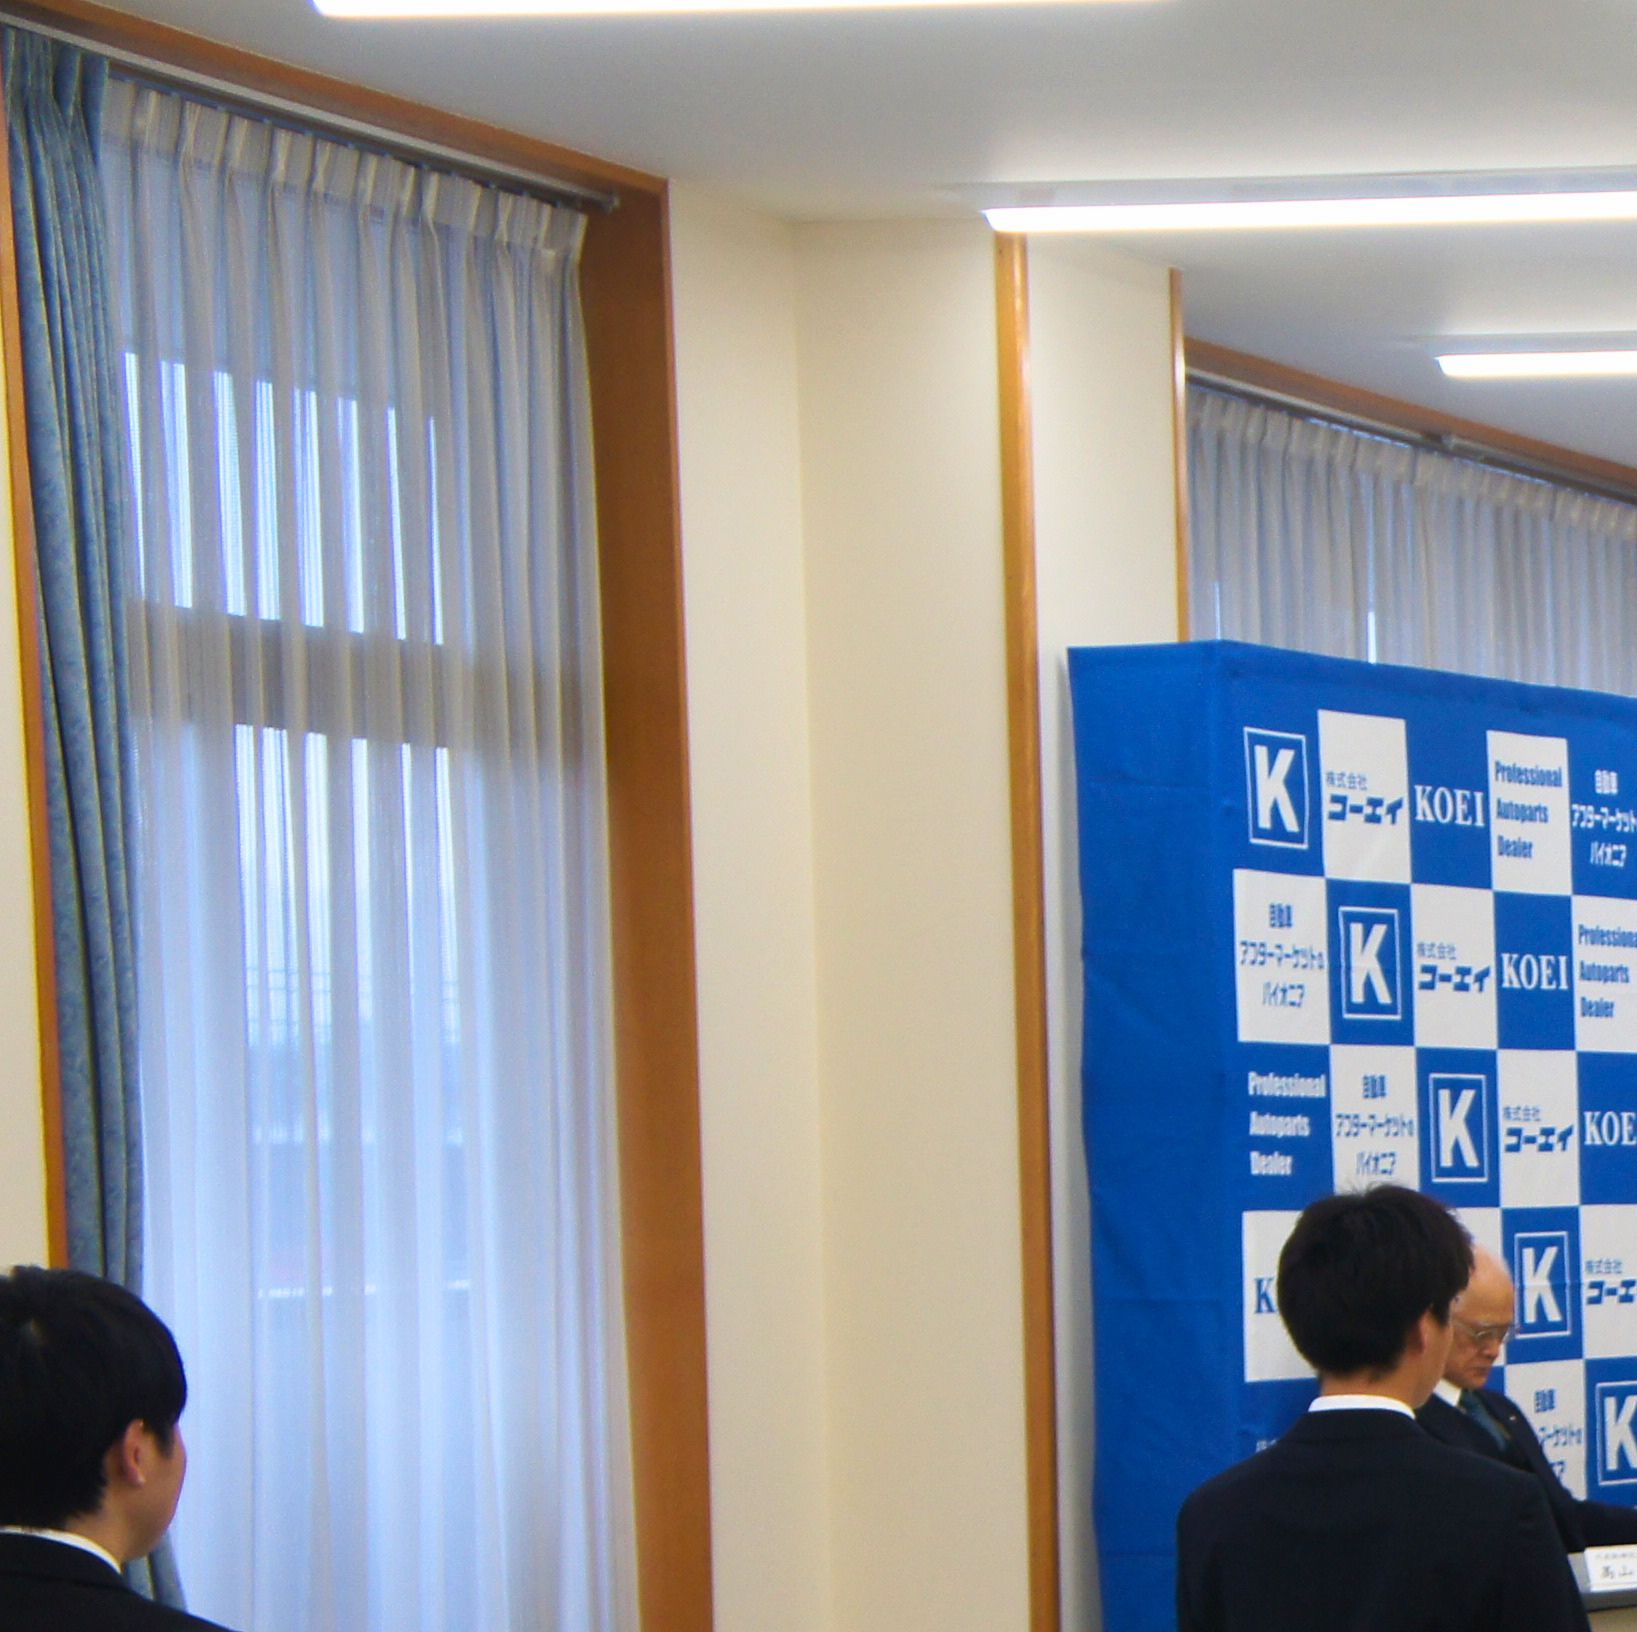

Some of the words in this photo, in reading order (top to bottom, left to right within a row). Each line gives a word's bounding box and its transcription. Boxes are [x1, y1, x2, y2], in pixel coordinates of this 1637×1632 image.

[1326, 771, 1368, 790] 株式会社
[1495, 761, 1563, 787] Professional
[1254, 745, 1300, 832] K
[1328, 794, 1404, 825] コーエイ
[1414, 784, 1485, 827] KOEI
[1497, 798, 1548, 823] Autoparts
[1498, 835, 1533, 859] Dealer
[1350, 922, 1393, 1004] K
[1417, 942, 1457, 960] 株式会社
[1418, 964, 1491, 993] コーエイ
[1501, 953, 1568, 990] KOEI
[1580, 960, 1630, 984] Autoparts
[1580, 996, 1614, 1018] Dealer
[1248, 1071, 1326, 1097] Professional
[1250, 1111, 1310, 1137] Autoparts
[1504, 1106, 1540, 1121] 株式会社
[1438, 1089, 1480, 1168] K
[1504, 1124, 1574, 1152] コーエイ
[1250, 1151, 1292, 1175] Dealer
[1586, 1259, 1622, 1274] 株式会社
[1522, 1246, 1562, 1324] K
